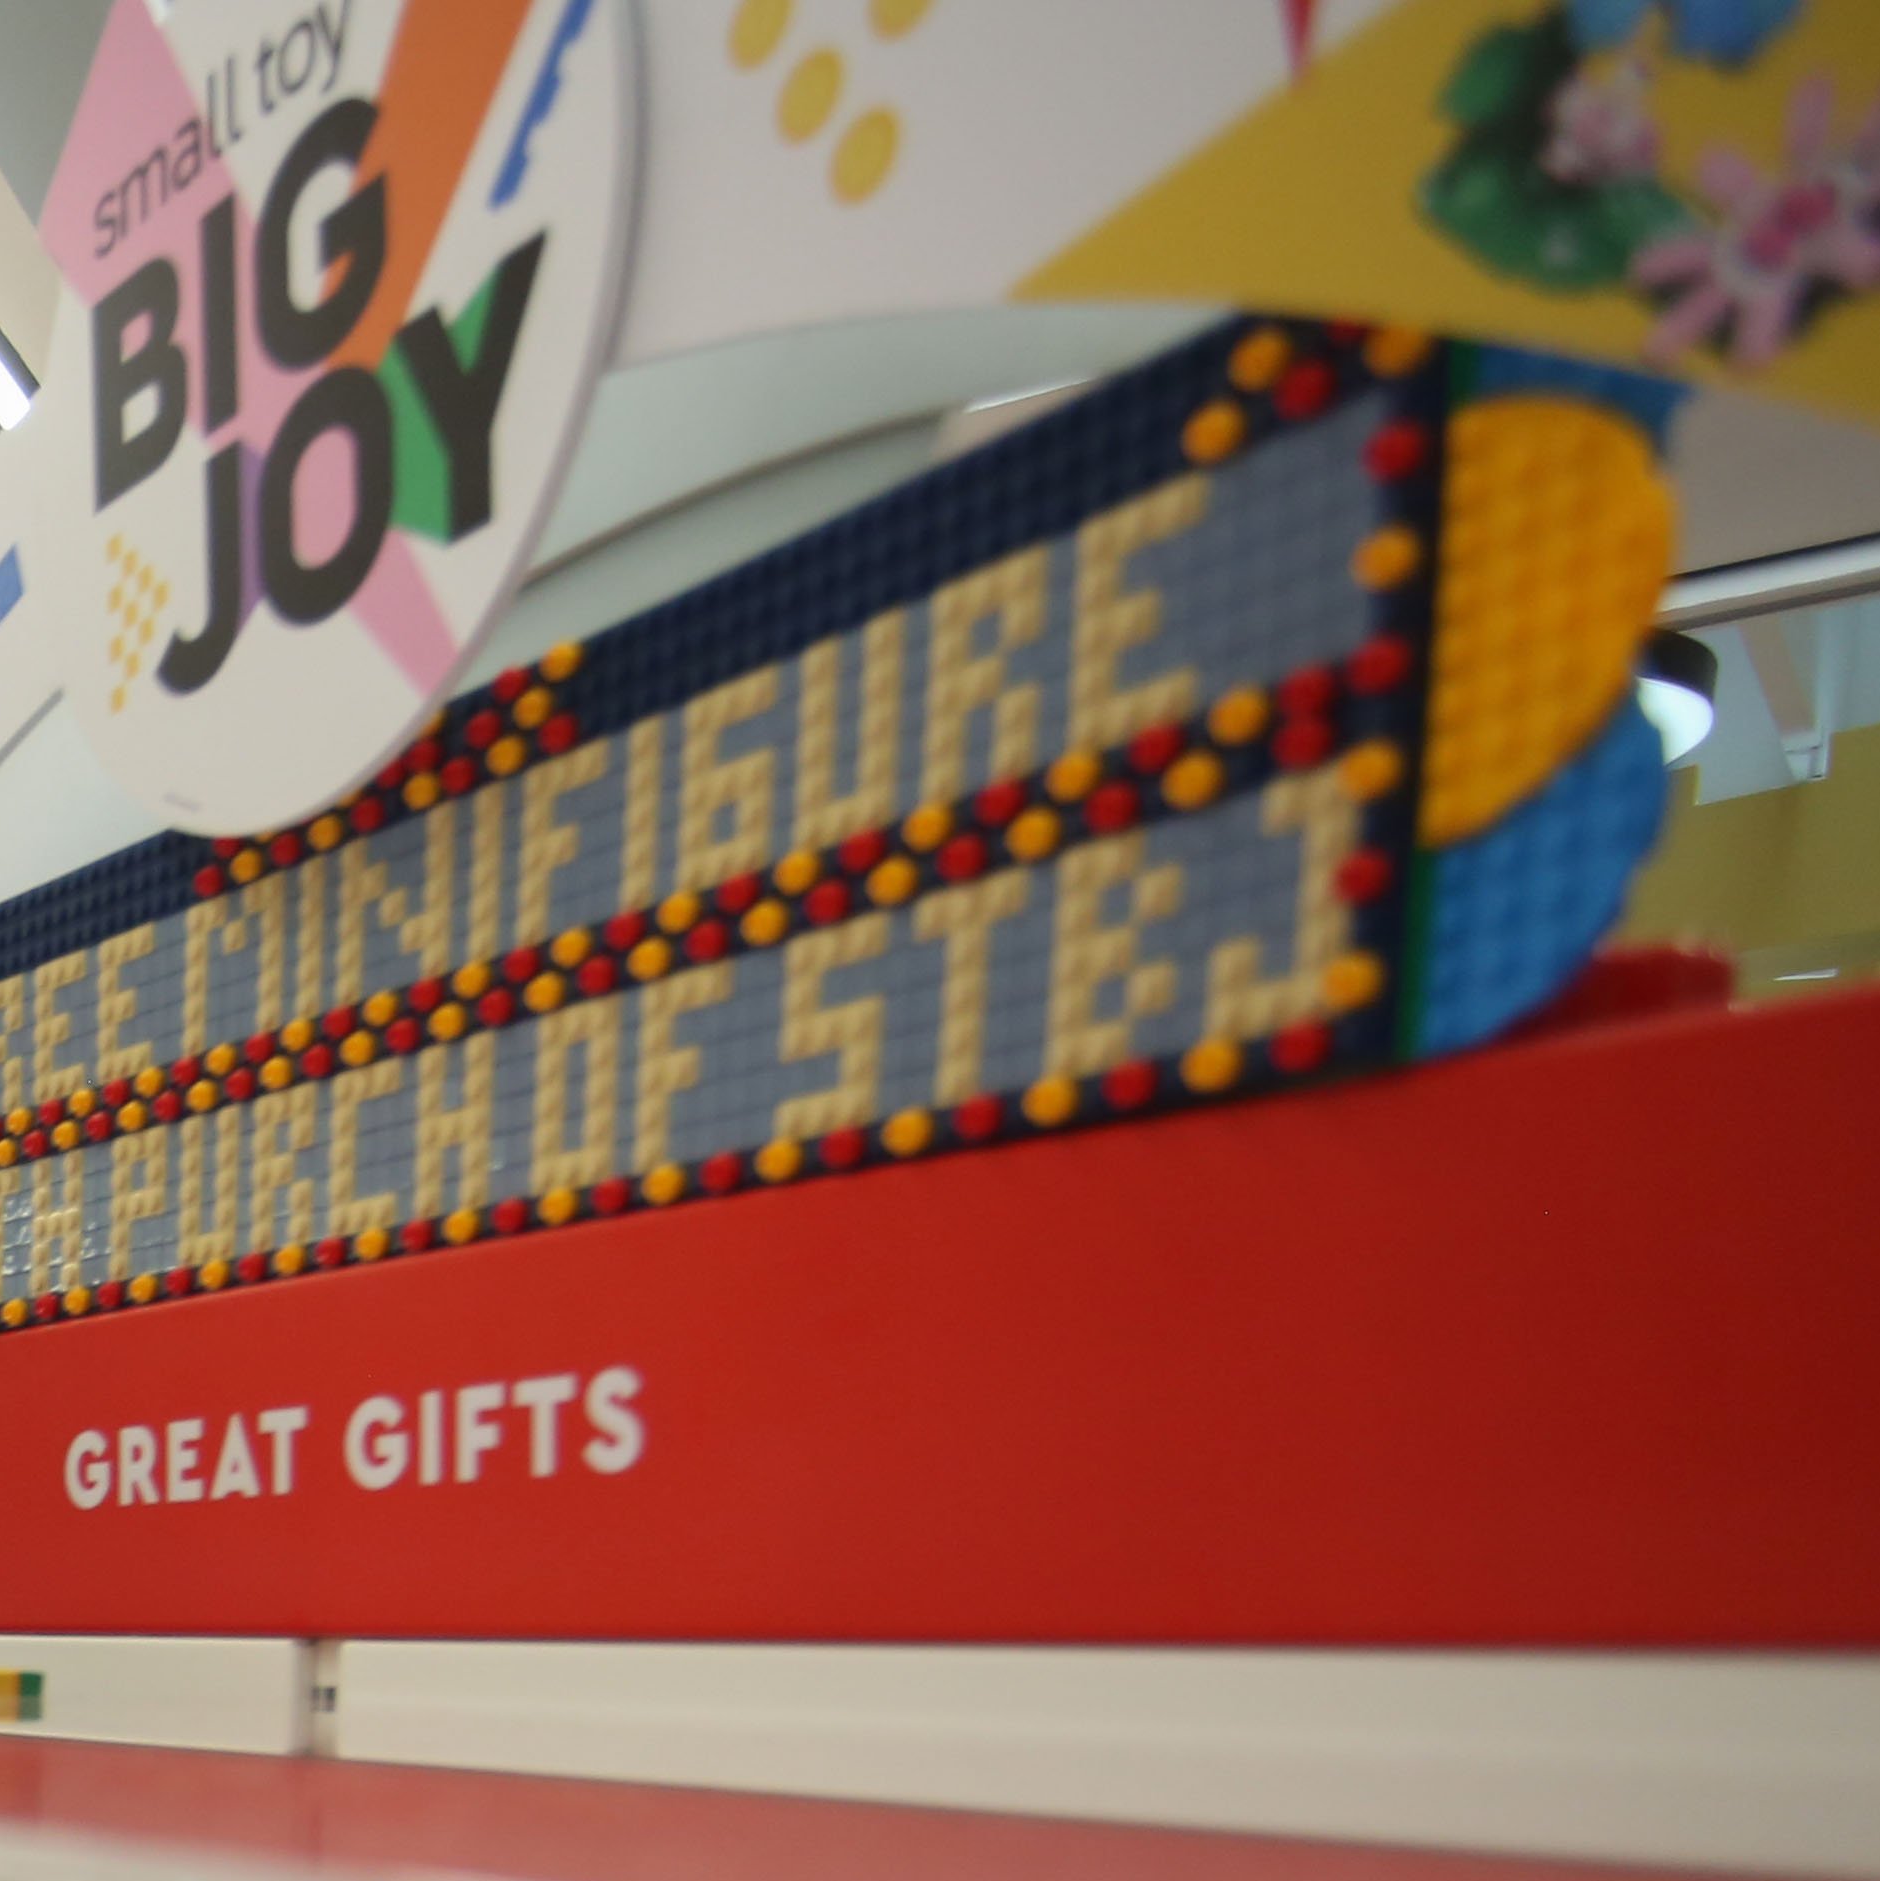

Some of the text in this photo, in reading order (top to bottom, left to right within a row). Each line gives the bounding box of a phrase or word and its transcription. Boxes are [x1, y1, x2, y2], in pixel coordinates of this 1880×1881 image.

[92, 97, 389, 516] BIG
[93, 0, 349, 260] small toy
[156, 228, 548, 697] JOY
[183, 474, 1211, 1056] MINIFIGURE
[109, 1028, 497, 1280] PURCH
[530, 961, 733, 1195] OF
[64, 1366, 644, 1510] GREAT GIFTS
